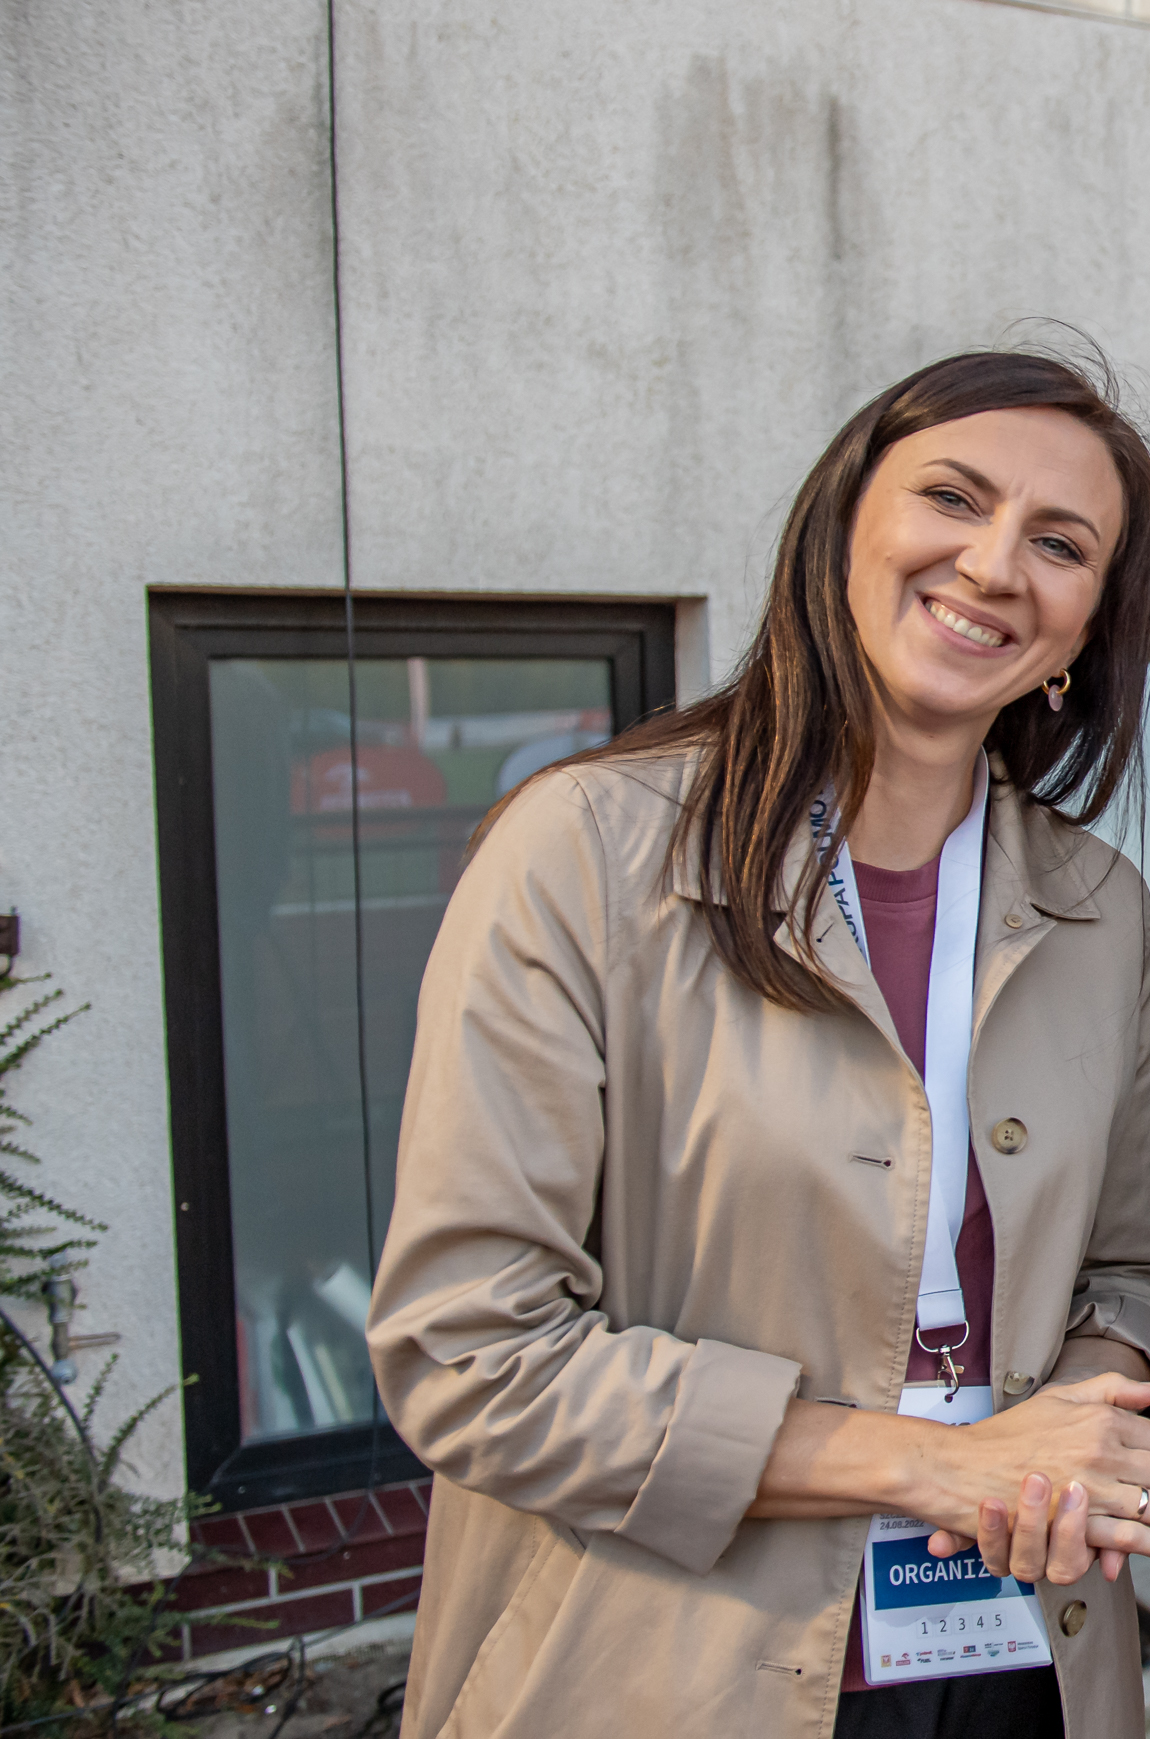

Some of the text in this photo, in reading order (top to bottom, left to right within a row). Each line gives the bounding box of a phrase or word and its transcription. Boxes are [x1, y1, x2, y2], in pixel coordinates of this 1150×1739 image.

[921, 1613, 1002, 1635] 1 2 3 4 5
